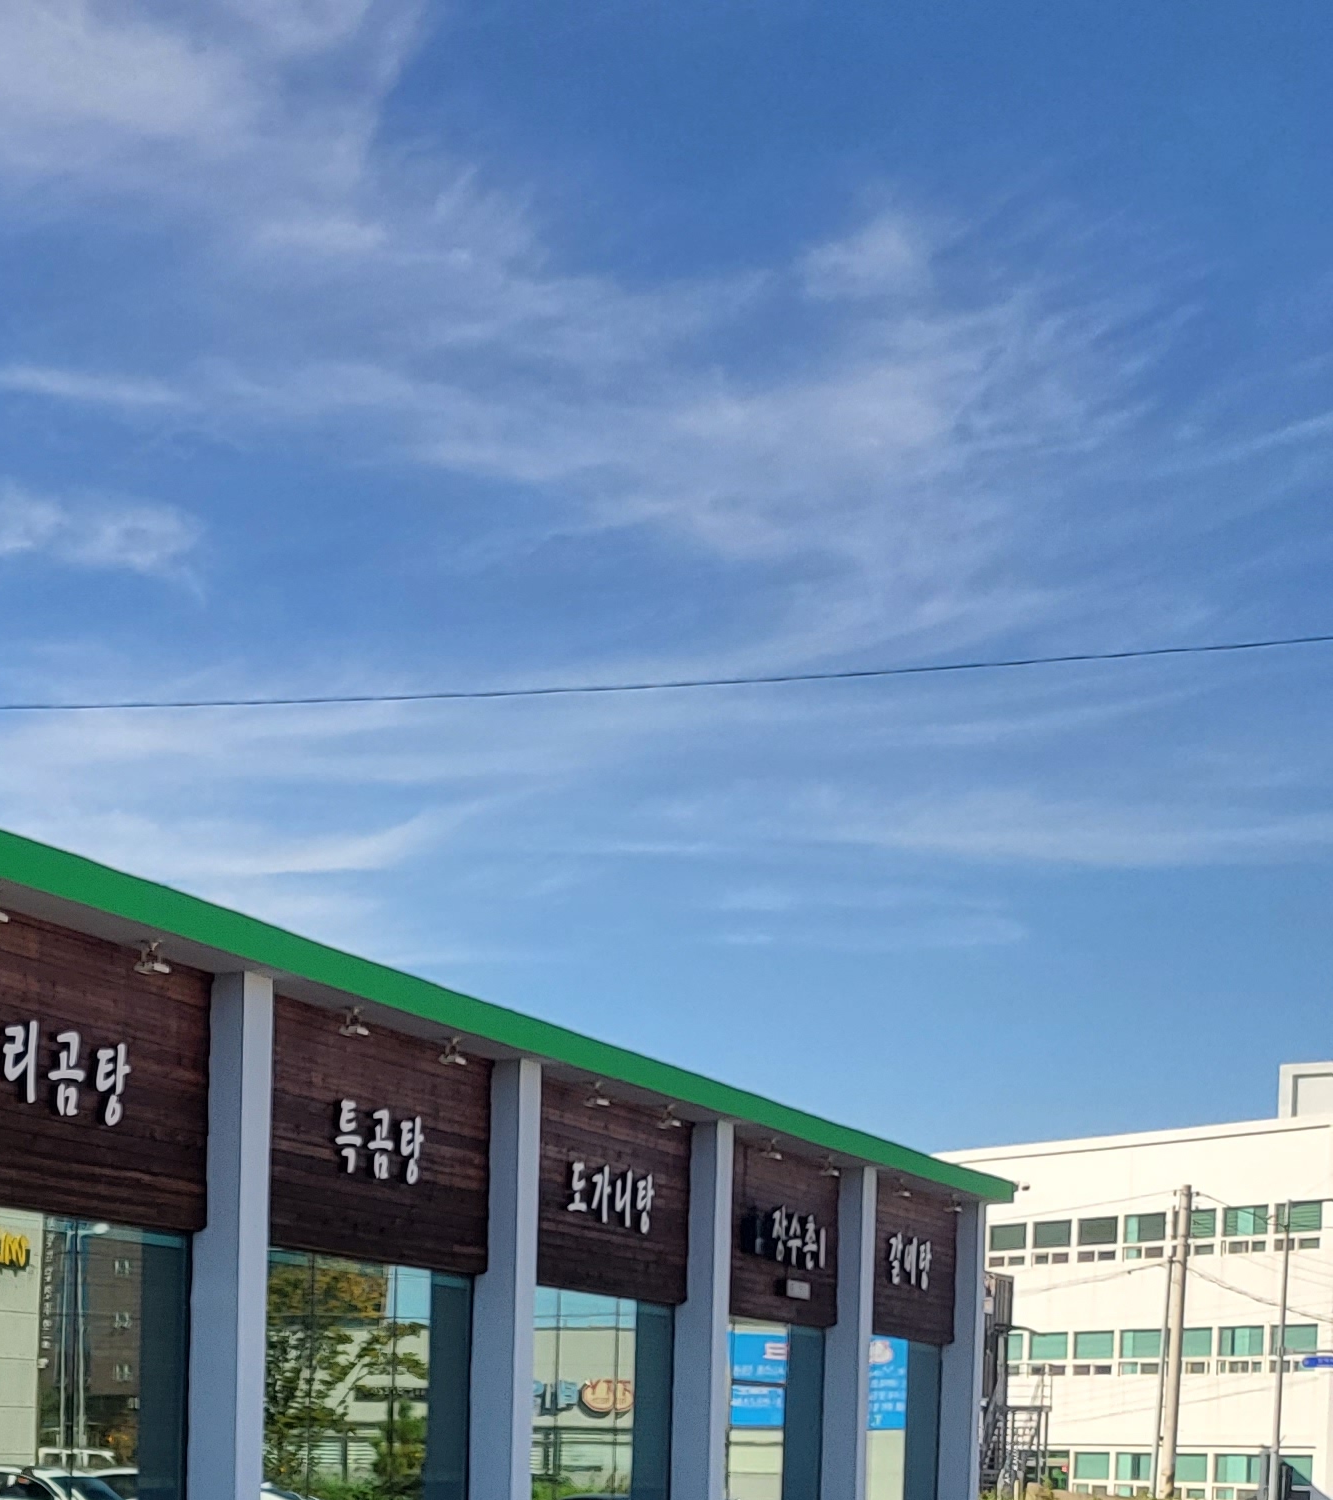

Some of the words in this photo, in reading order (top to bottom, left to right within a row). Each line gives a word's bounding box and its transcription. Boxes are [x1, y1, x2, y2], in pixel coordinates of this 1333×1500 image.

[335, 1098, 424, 1186] 특곰탕
[567, 1160, 656, 1236] 도가니탕
[772, 1204, 819, 1271] 장수촌
[889, 1231, 933, 1292] 갈비탕
